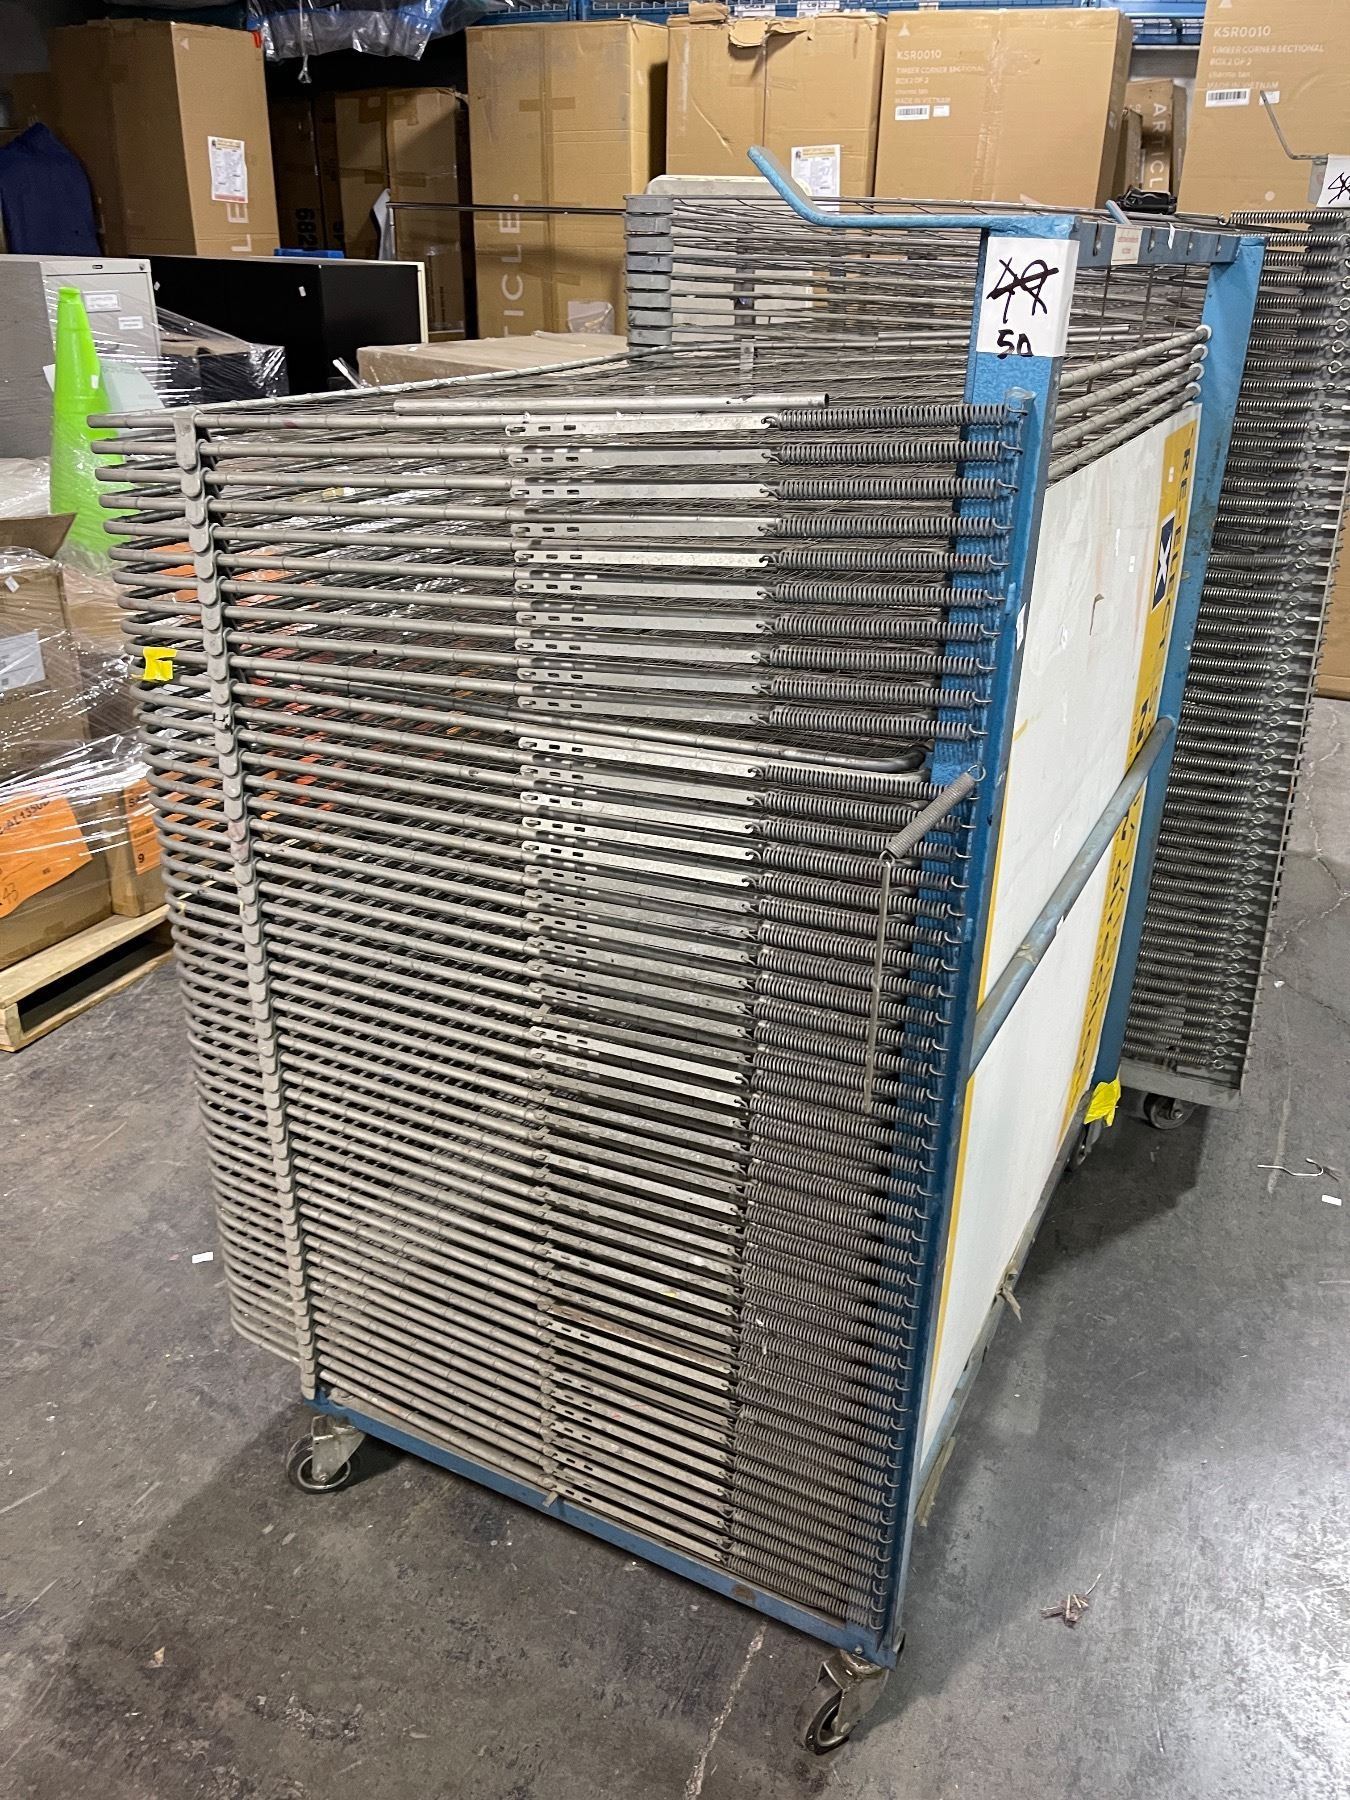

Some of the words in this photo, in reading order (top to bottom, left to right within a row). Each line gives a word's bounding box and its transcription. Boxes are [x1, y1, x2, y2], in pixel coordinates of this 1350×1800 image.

[1213, 25, 1272, 38] KSR0010
[1277, 44, 1325, 53] SECTIONAL
[896, 49, 942, 60] KSR0010
